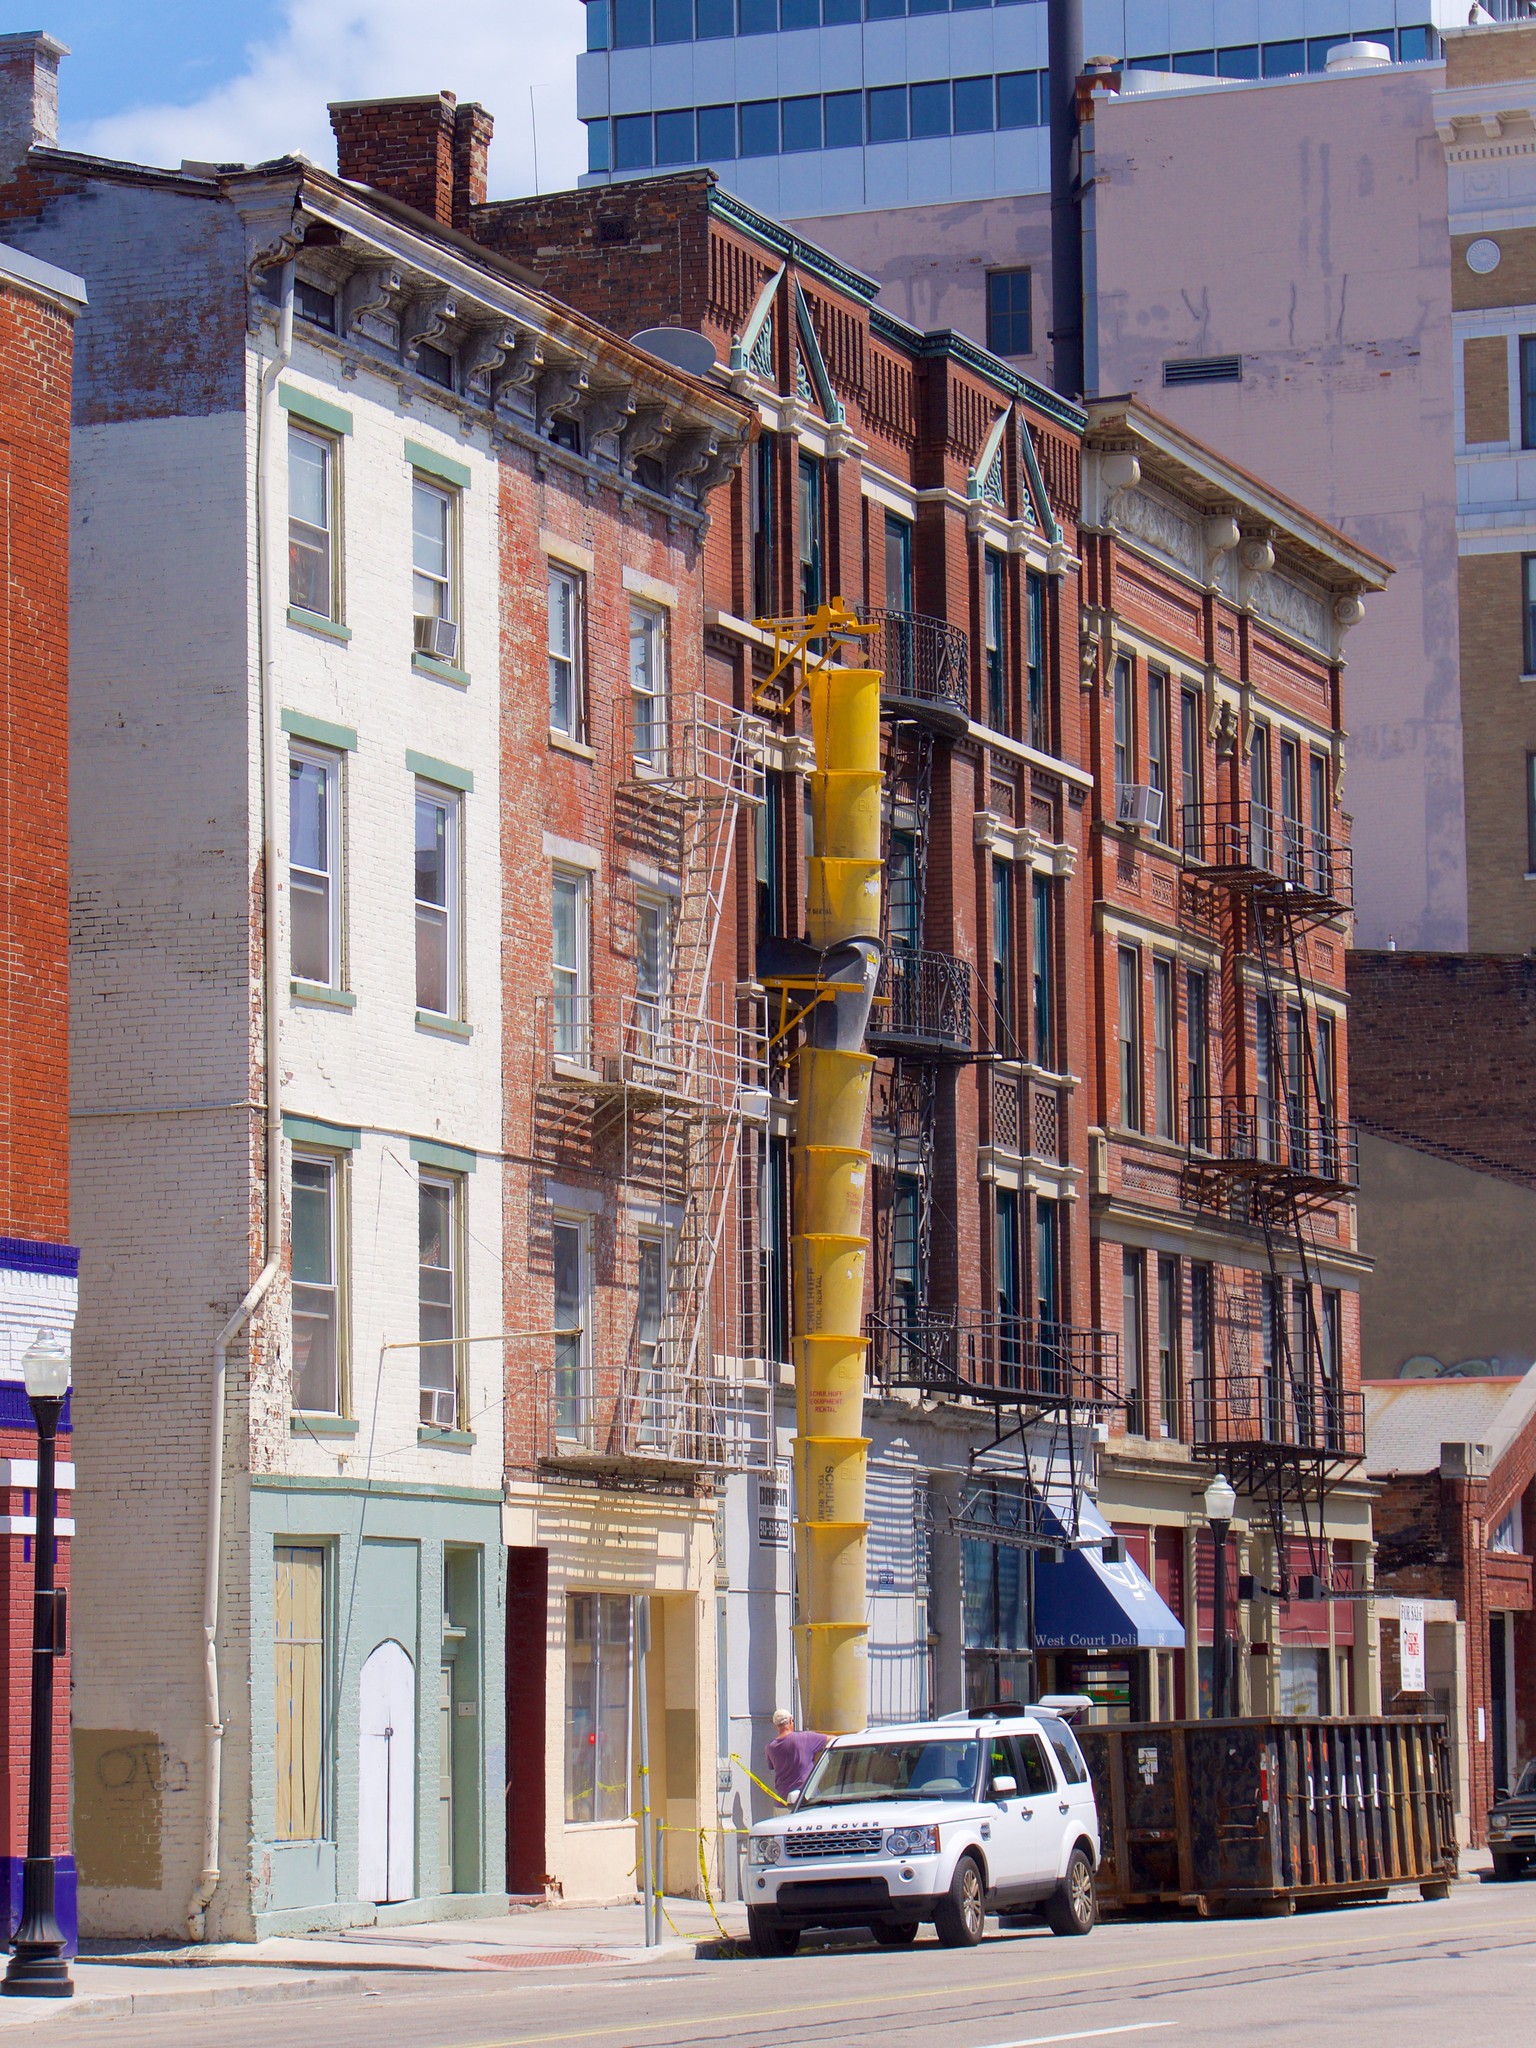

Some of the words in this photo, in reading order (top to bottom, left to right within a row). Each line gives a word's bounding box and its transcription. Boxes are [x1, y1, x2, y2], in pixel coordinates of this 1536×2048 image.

[815, 1309, 823, 1330] TOOL
[817, 1475, 825, 1497] TOOL
[1401, 1604, 1410, 1620] FOR
[1411, 1605, 1423, 1621] SALE
[1035, 1634, 1065, 1646] West
[1070, 1633, 1106, 1646] Court
[1111, 1633, 1137, 1646] Deli
[787, 1824, 823, 1832] LAND
[831, 1821, 880, 1829] ROVER
